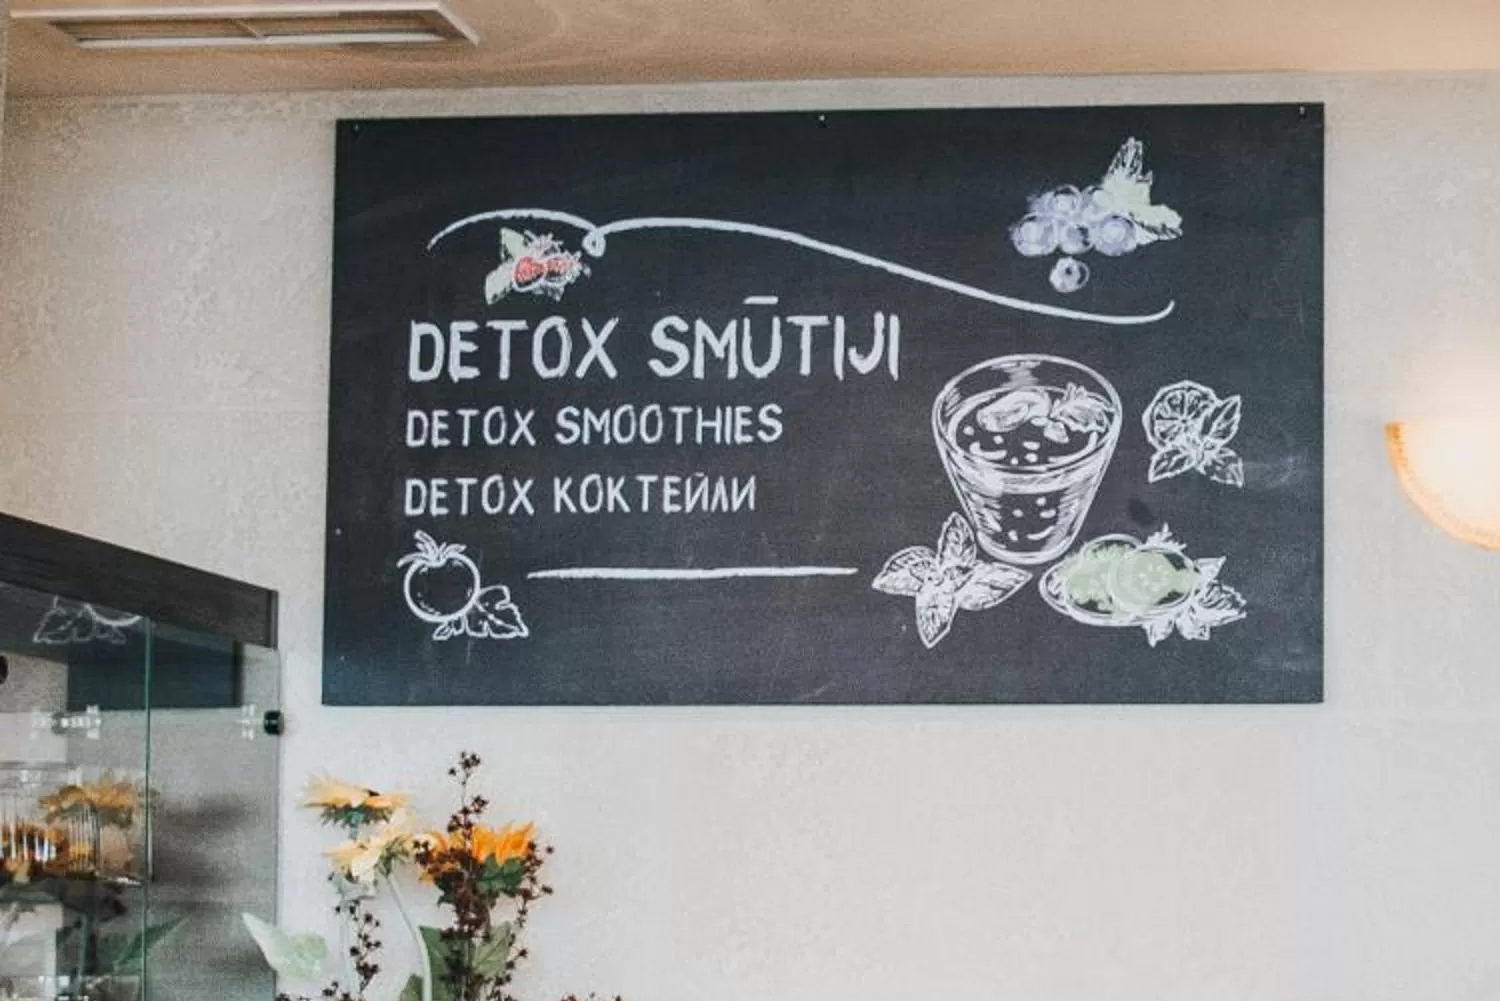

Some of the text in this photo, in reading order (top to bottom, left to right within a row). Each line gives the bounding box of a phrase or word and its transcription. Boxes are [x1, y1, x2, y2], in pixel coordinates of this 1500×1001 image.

[408, 295, 899, 382] DETOX SMŪTIJI
[405, 404, 783, 447] DETOX SMOOTHIES
[404, 472, 757, 517] DETOX КОКТЕЙЛИ
